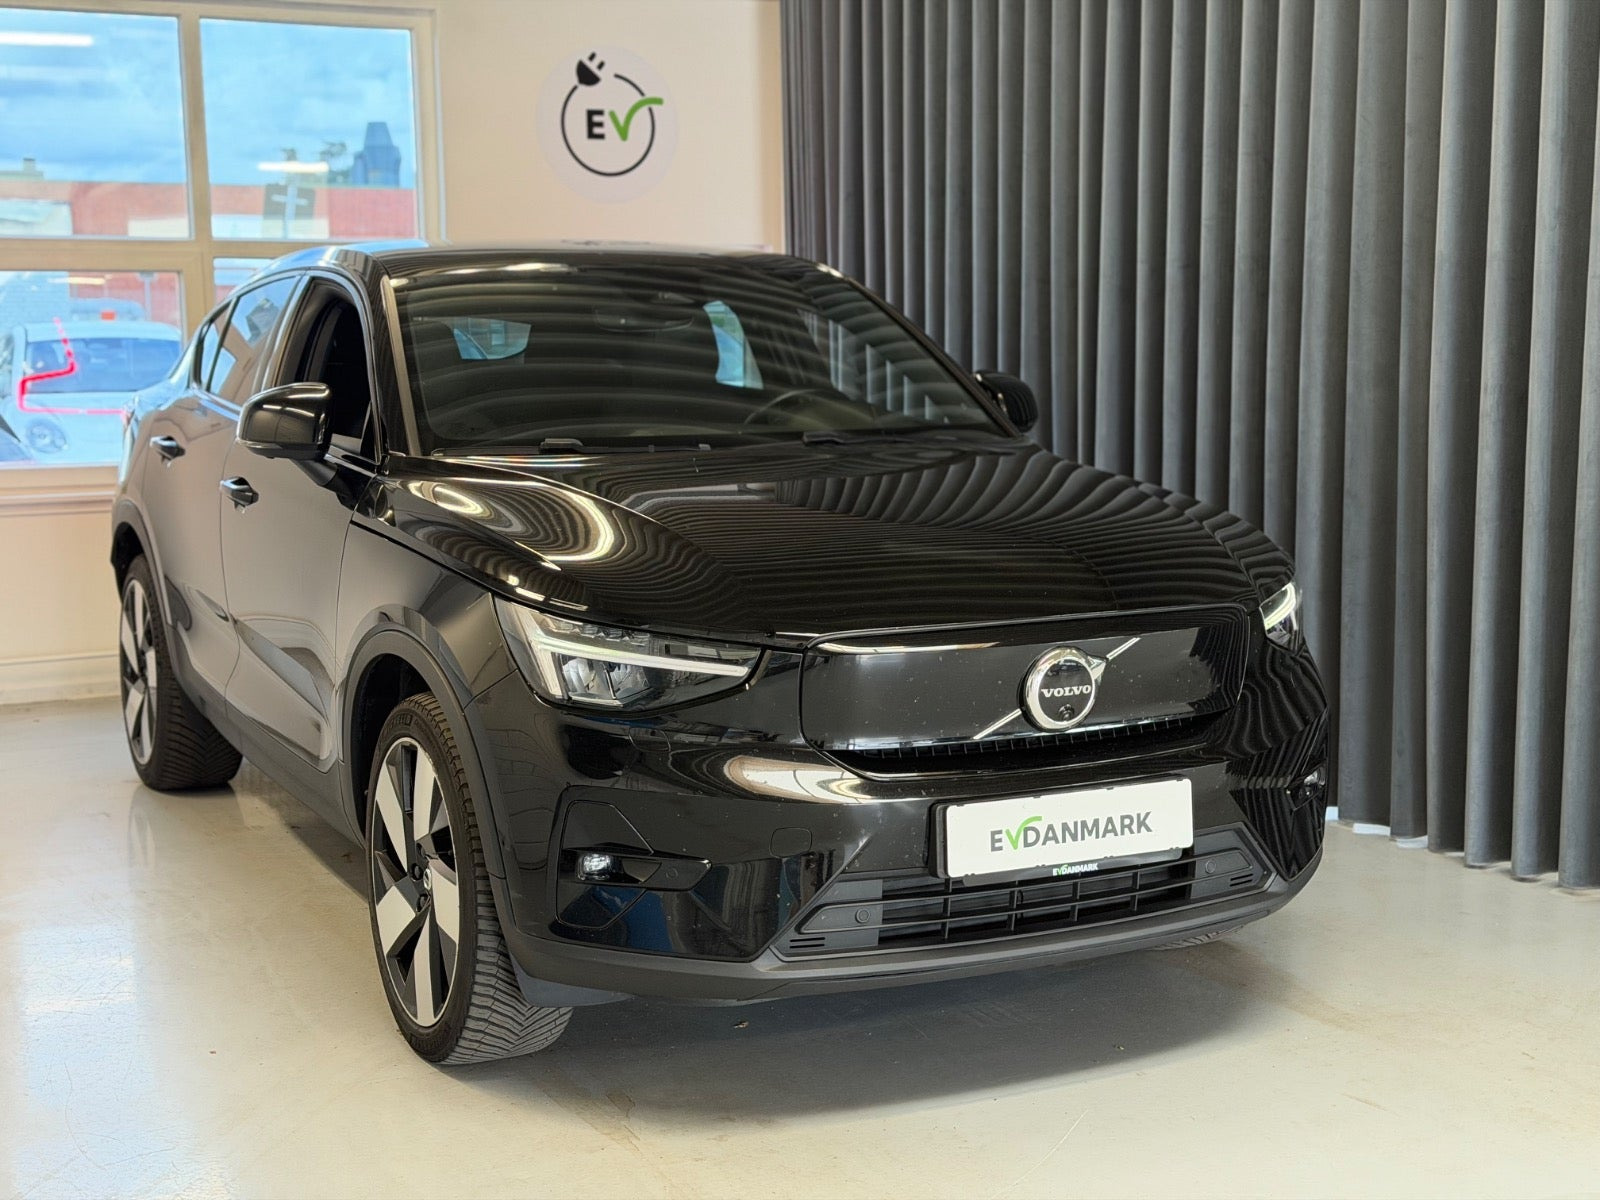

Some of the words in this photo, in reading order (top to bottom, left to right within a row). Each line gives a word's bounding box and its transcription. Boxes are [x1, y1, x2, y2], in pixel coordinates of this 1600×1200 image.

[586, 97, 664, 142] EV
[1041, 685, 1092, 698] VOLVO
[990, 811, 1153, 852] EVDANMARK
